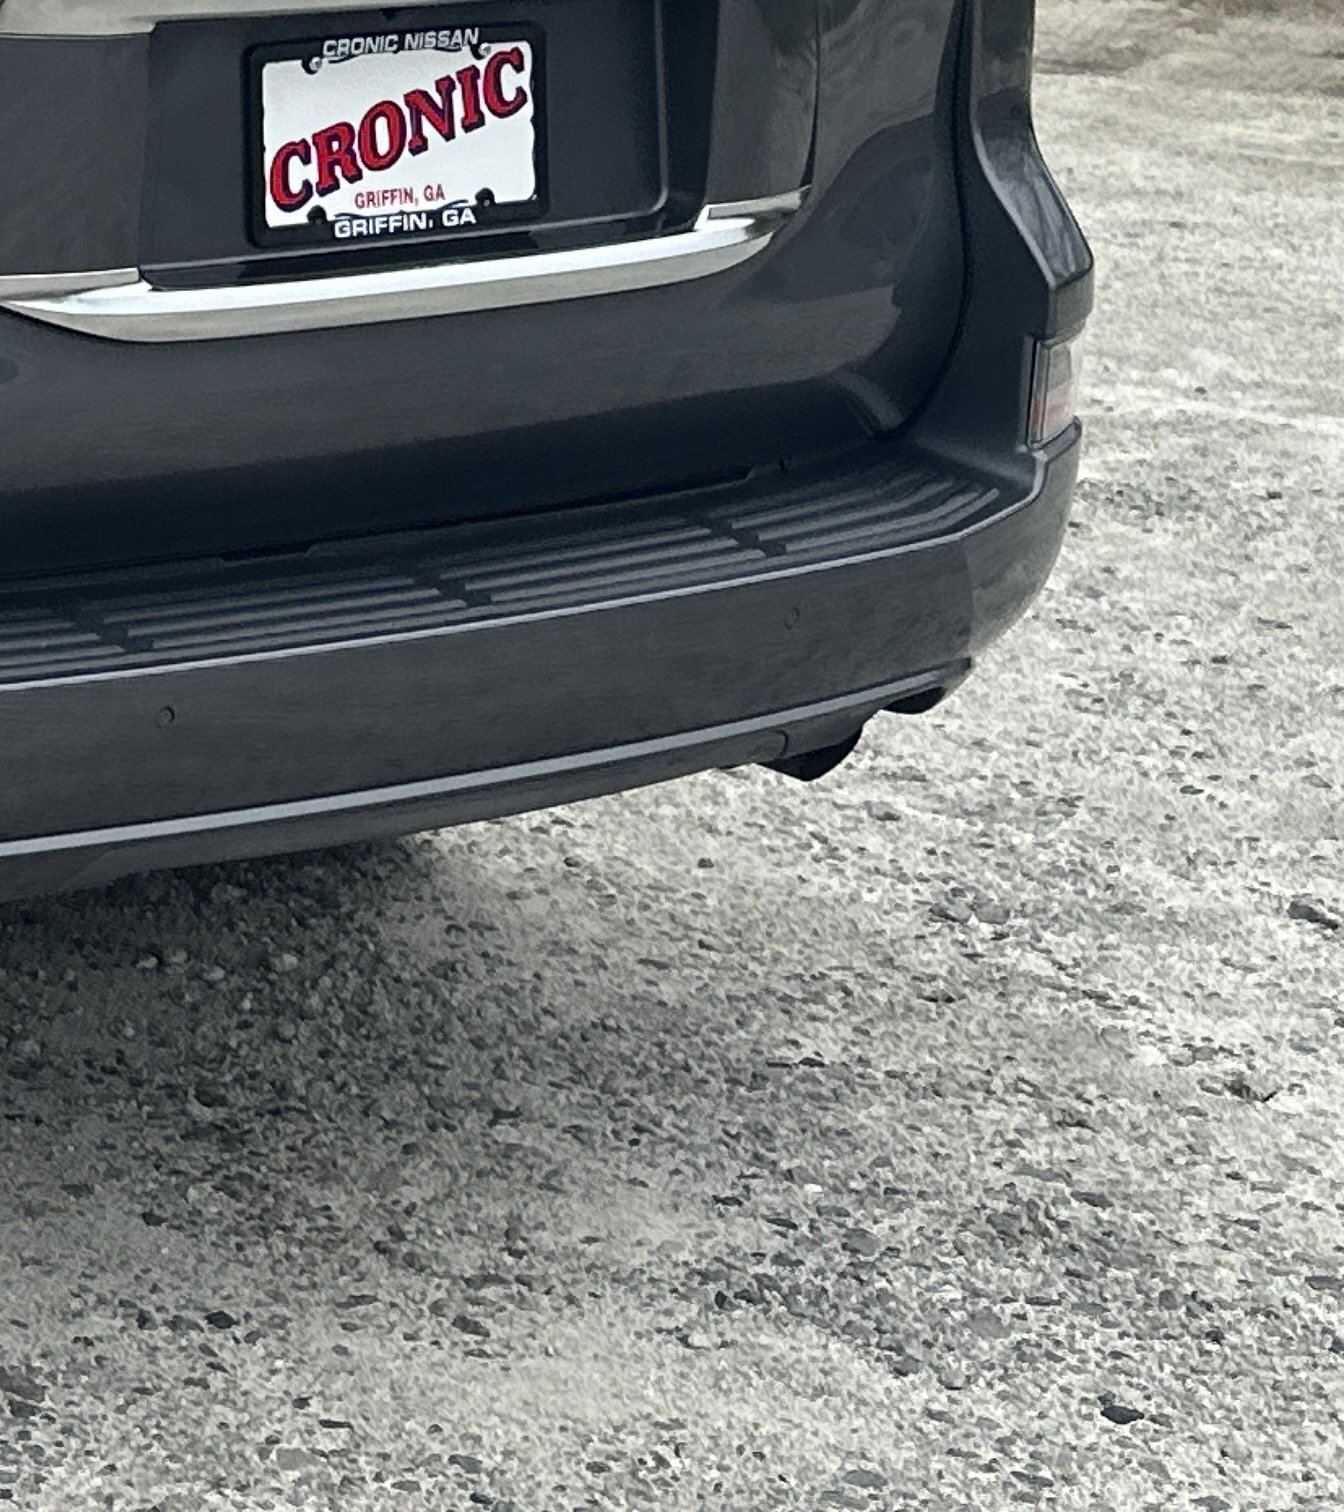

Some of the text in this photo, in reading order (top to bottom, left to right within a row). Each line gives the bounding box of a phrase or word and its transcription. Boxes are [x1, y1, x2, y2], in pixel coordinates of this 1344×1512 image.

[323, 27, 480, 57] CRONIC NISSAN
[269, 46, 528, 212] CRONIC
[354, 184, 446, 209] GRIFFIN, GA
[442, 207, 477, 227] GA
